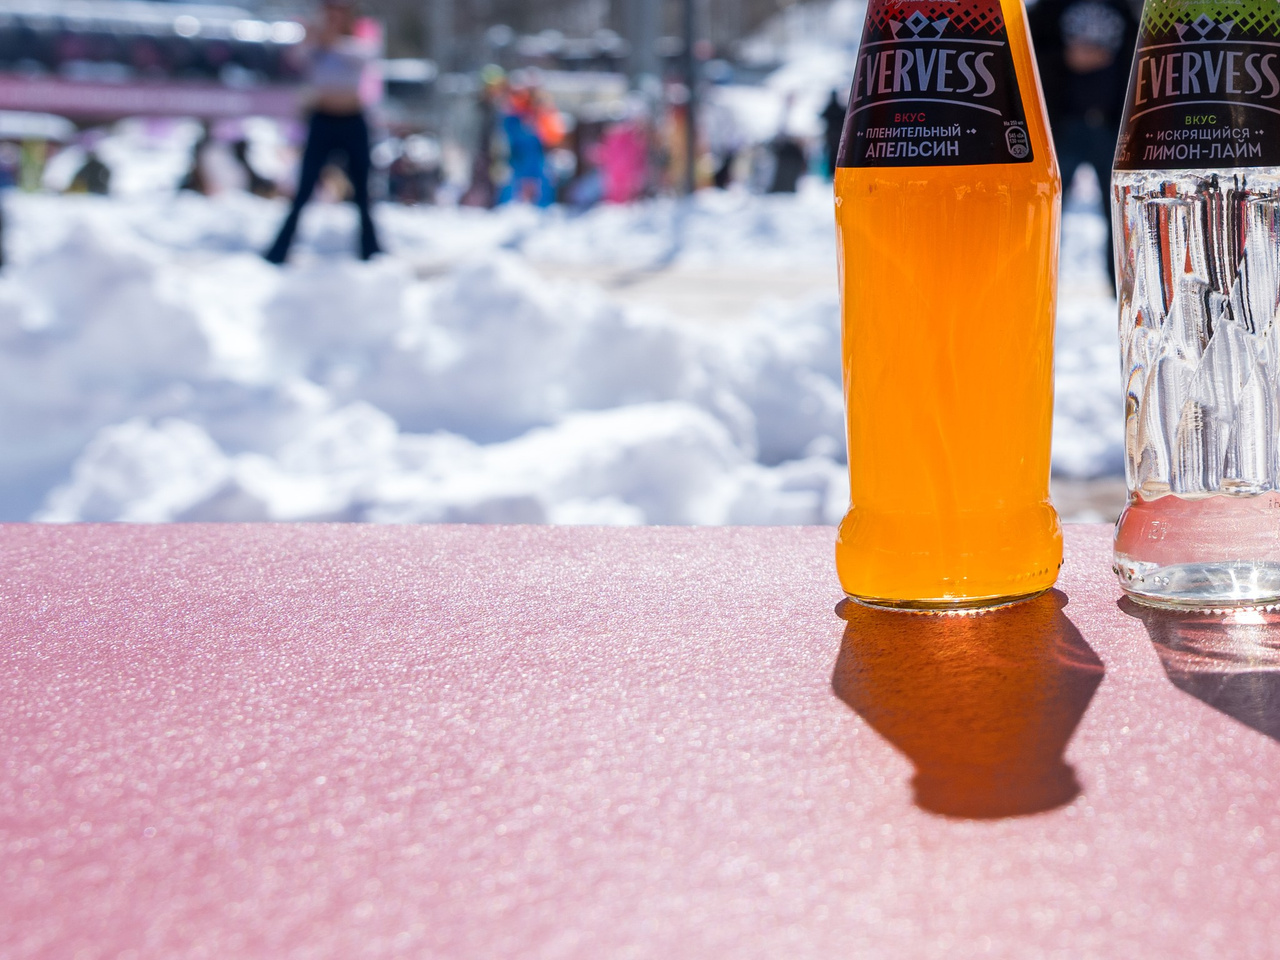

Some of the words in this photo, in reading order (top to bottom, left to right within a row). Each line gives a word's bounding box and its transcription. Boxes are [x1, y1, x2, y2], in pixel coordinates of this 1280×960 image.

[853, 48, 996, 104] EVERVESS
[1134, 50, 1280, 106] EVERVESS
[894, 112, 926, 123] ВКУС
[1185, 115, 1217, 125] ВКУС
[866, 123, 961, 139] ПЛЕНИТЕЛЬНЫЙ
[1157, 126, 1250, 142] ИСКРЯЩИЙСЯ
[865, 141, 959, 159] АПЕЛЬСИН
[1143, 139, 1262, 161] ЛИМОН-ЛАЙМ
